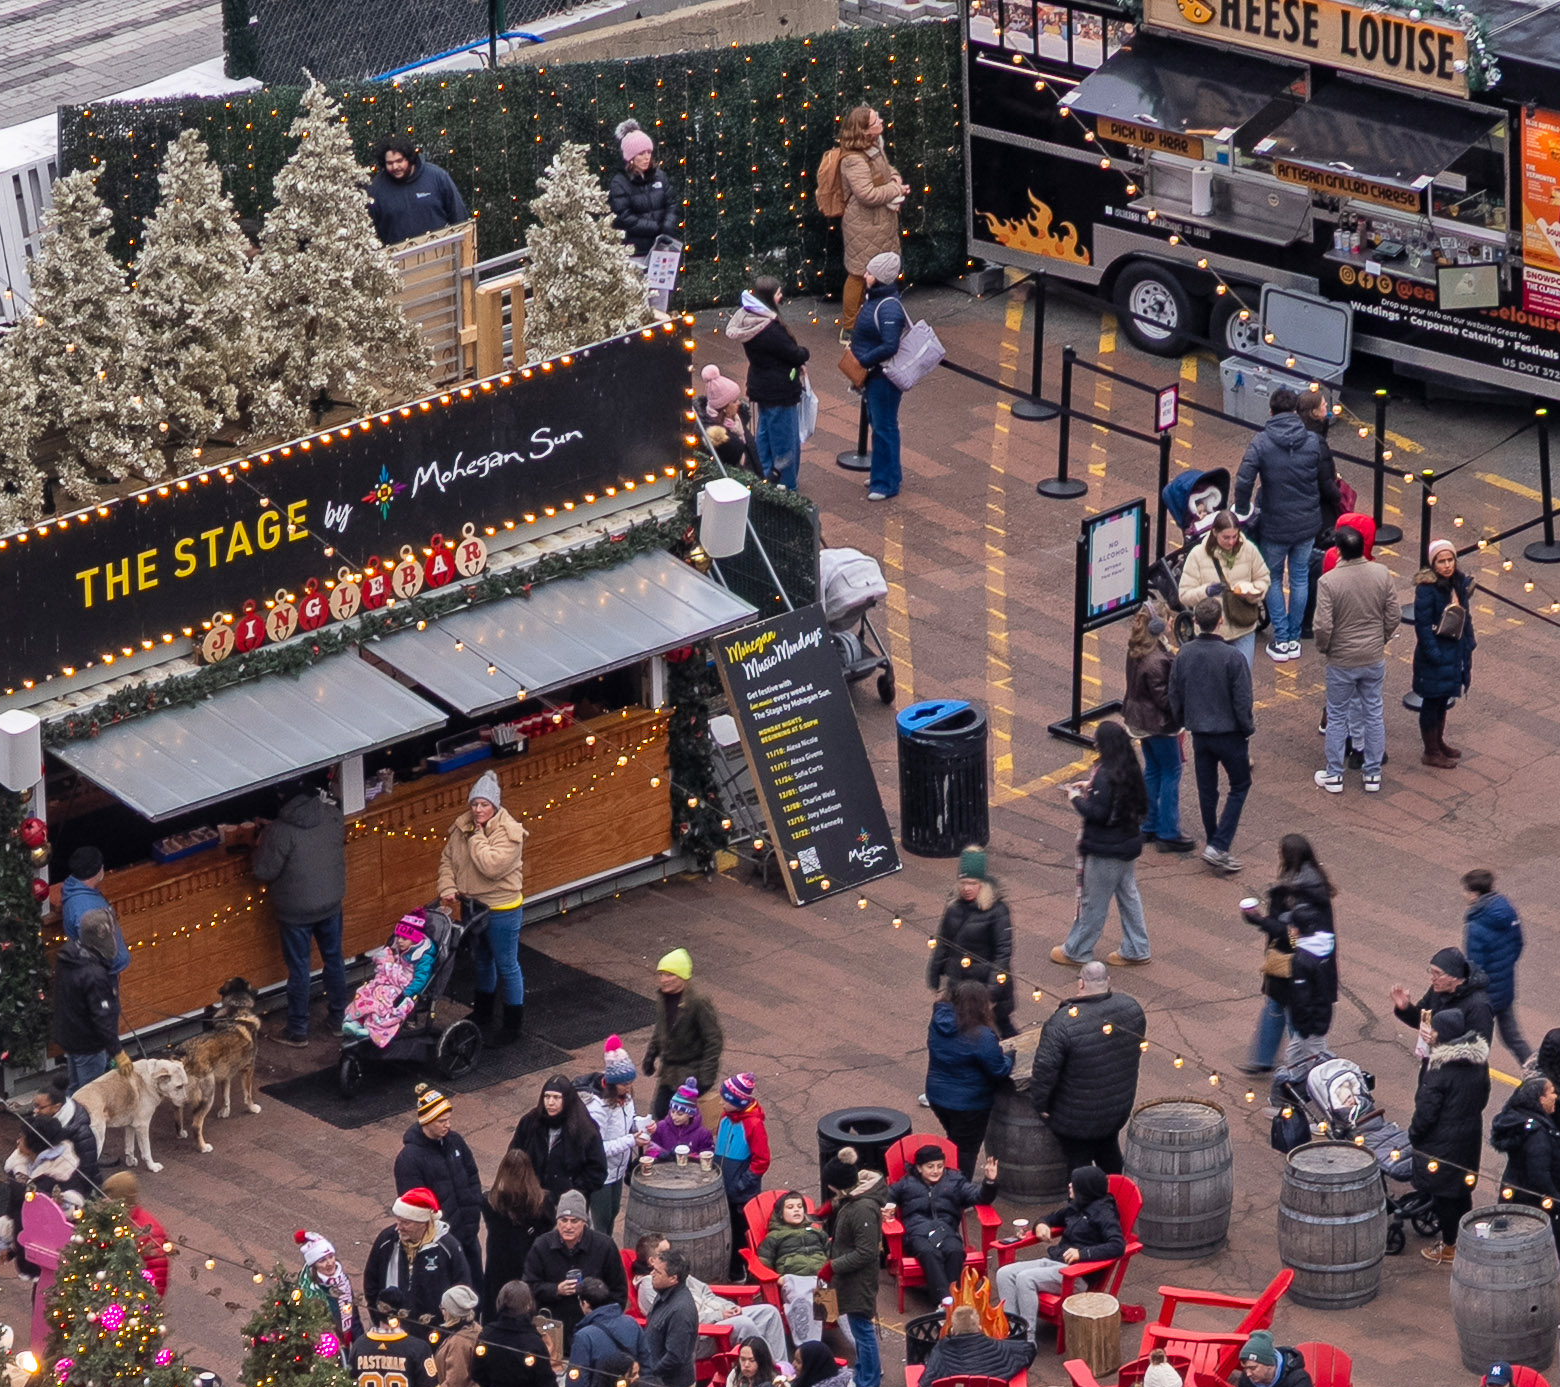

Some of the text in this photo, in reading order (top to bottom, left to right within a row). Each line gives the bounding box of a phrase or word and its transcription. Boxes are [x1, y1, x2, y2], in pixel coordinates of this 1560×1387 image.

[1340, 10, 1455, 81] LOUISE
[1110, 122, 1137, 139] PICK
[1139, 128, 1155, 143] UP
[1277, 163, 1416, 207] ARTISAN GRILLED CHEESE
[1350, 300, 1560, 361] Weddings Corporate Catering Festivals
[75, 426, 585, 609] THE STAGE by Mohegan Sun
[1097, 546, 1129, 564] ALCOHOL
[1107, 539, 1119, 549] NO
[725, 629, 777, 664] Mohegan
